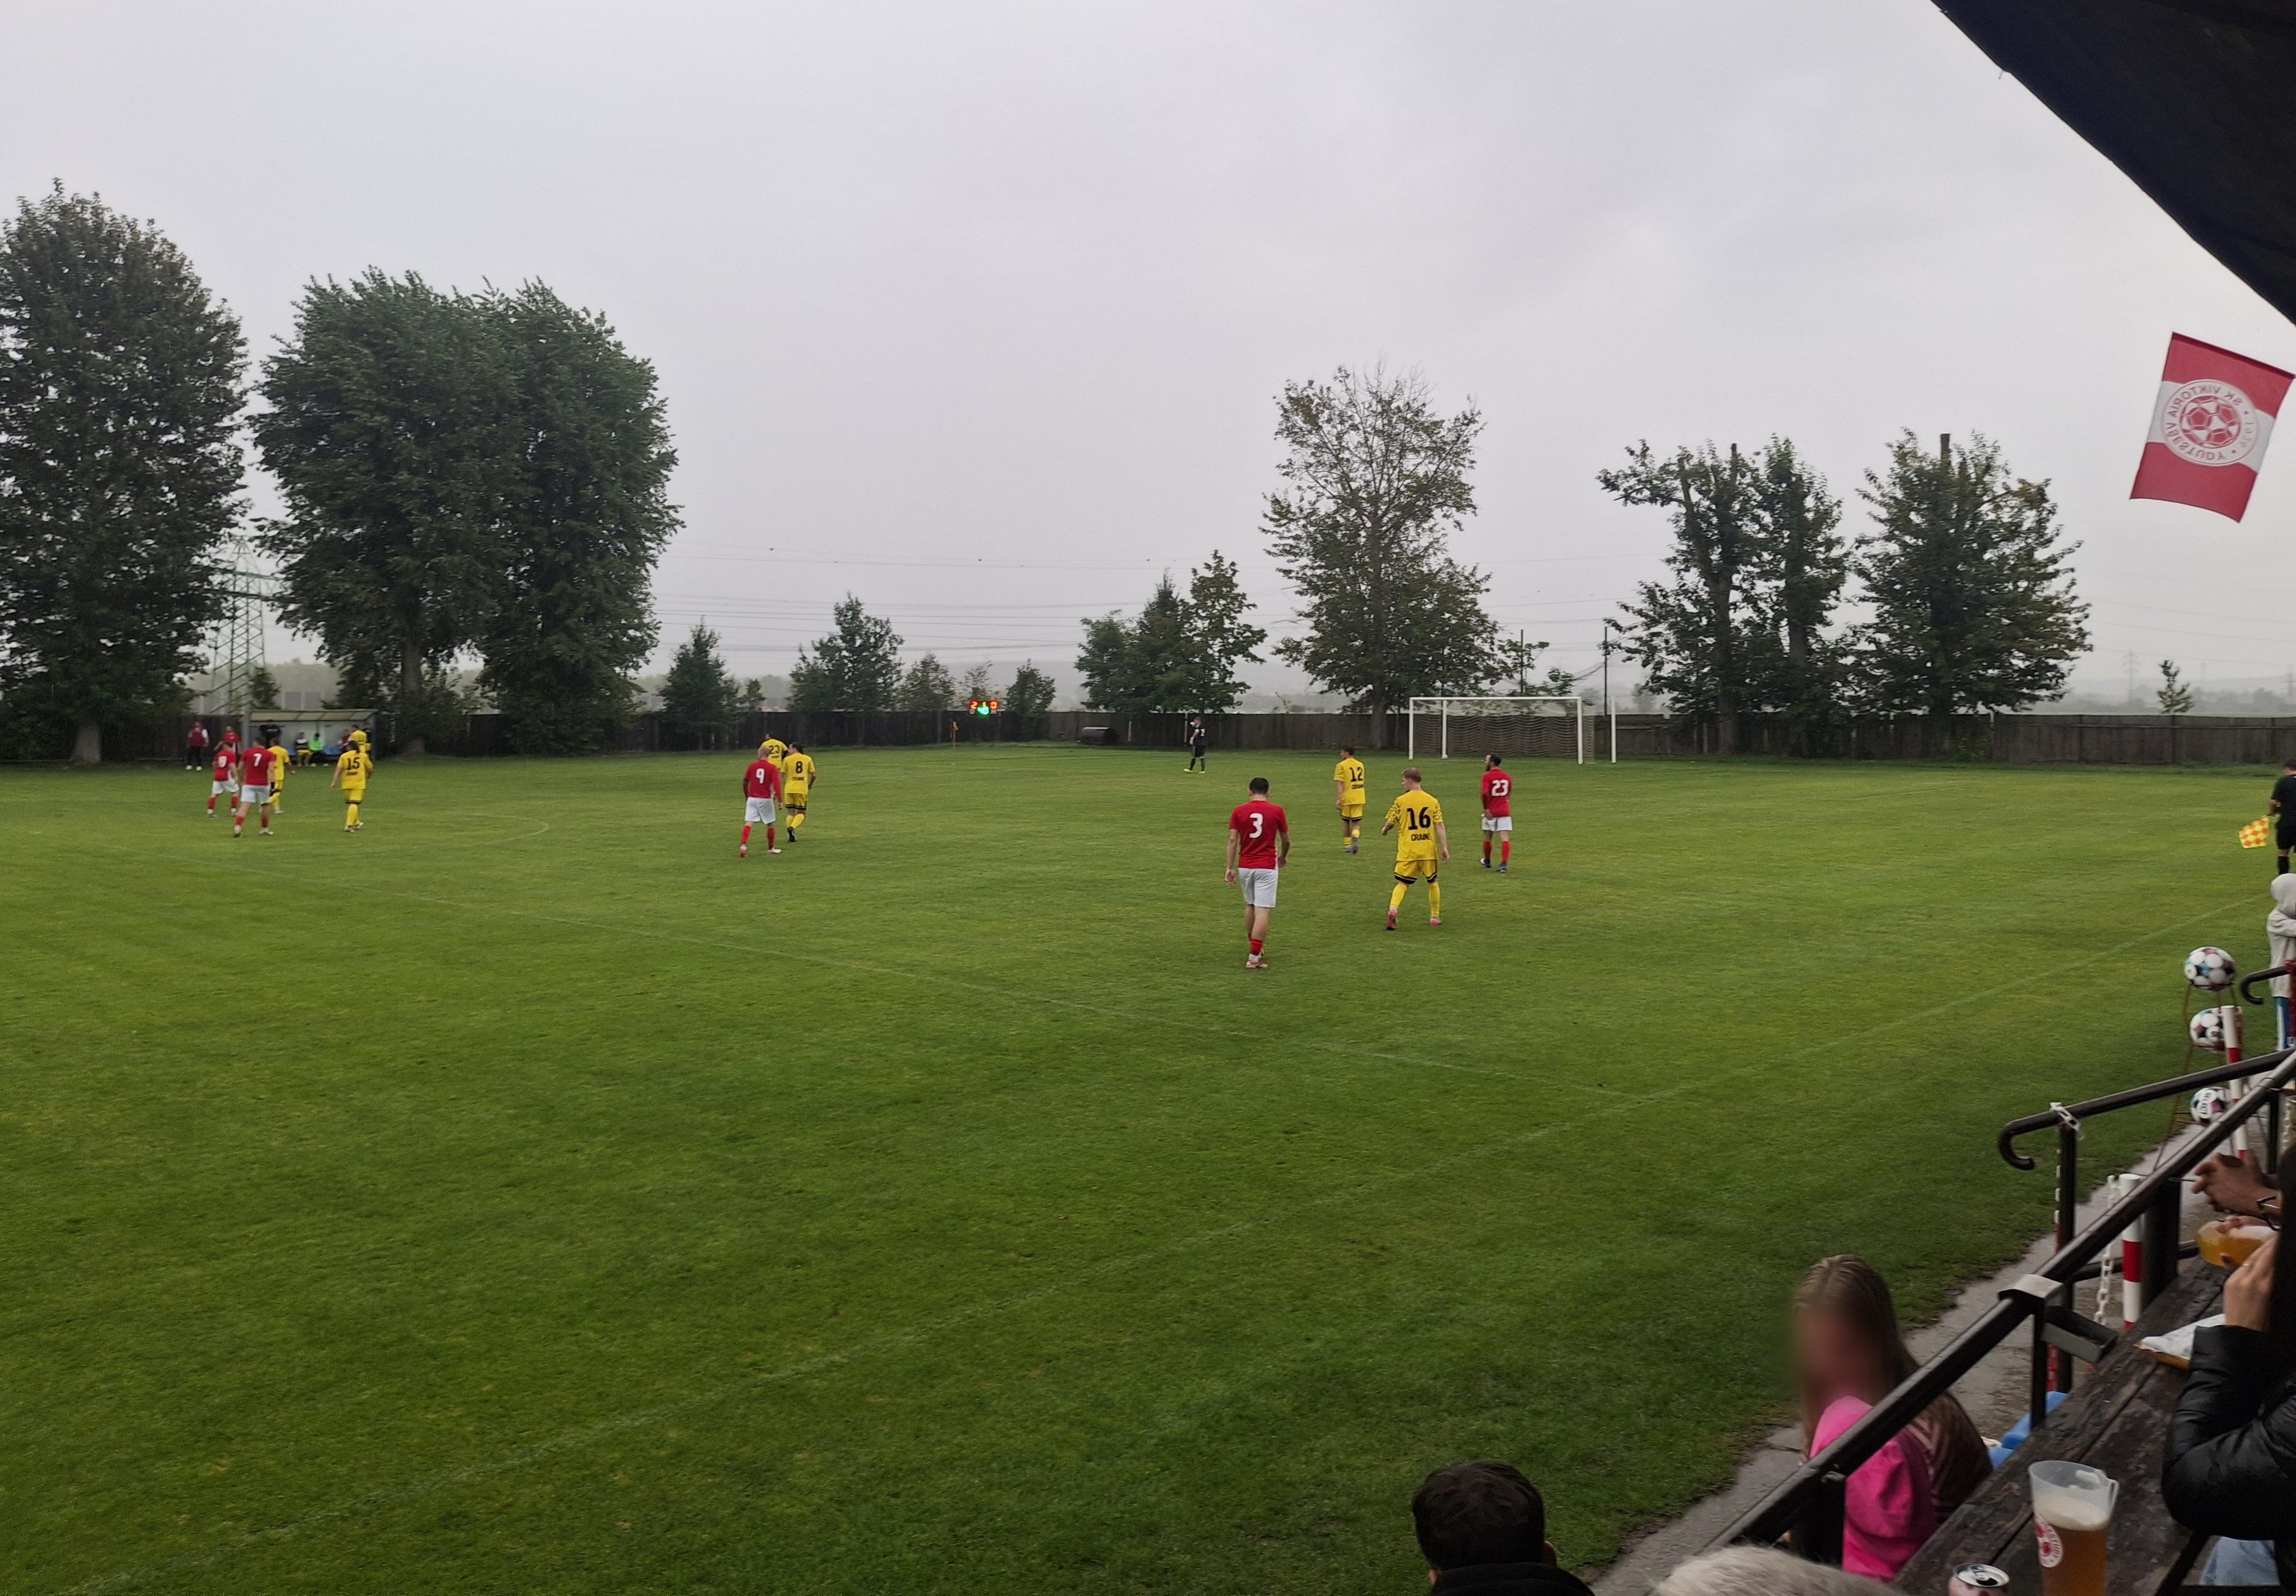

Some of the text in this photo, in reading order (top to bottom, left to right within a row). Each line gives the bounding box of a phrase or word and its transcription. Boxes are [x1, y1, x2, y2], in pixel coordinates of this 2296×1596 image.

[769, 745, 780, 754] 23
[253, 753, 262, 767] 7
[347, 757, 360, 770] 15
[796, 761, 803, 774] 8
[755, 768, 765, 784] 9
[1349, 765, 1363, 782] 12
[1491, 779, 1509, 797] 23
[1249, 812, 1264, 838] 3
[1407, 807, 1431, 830] 16
